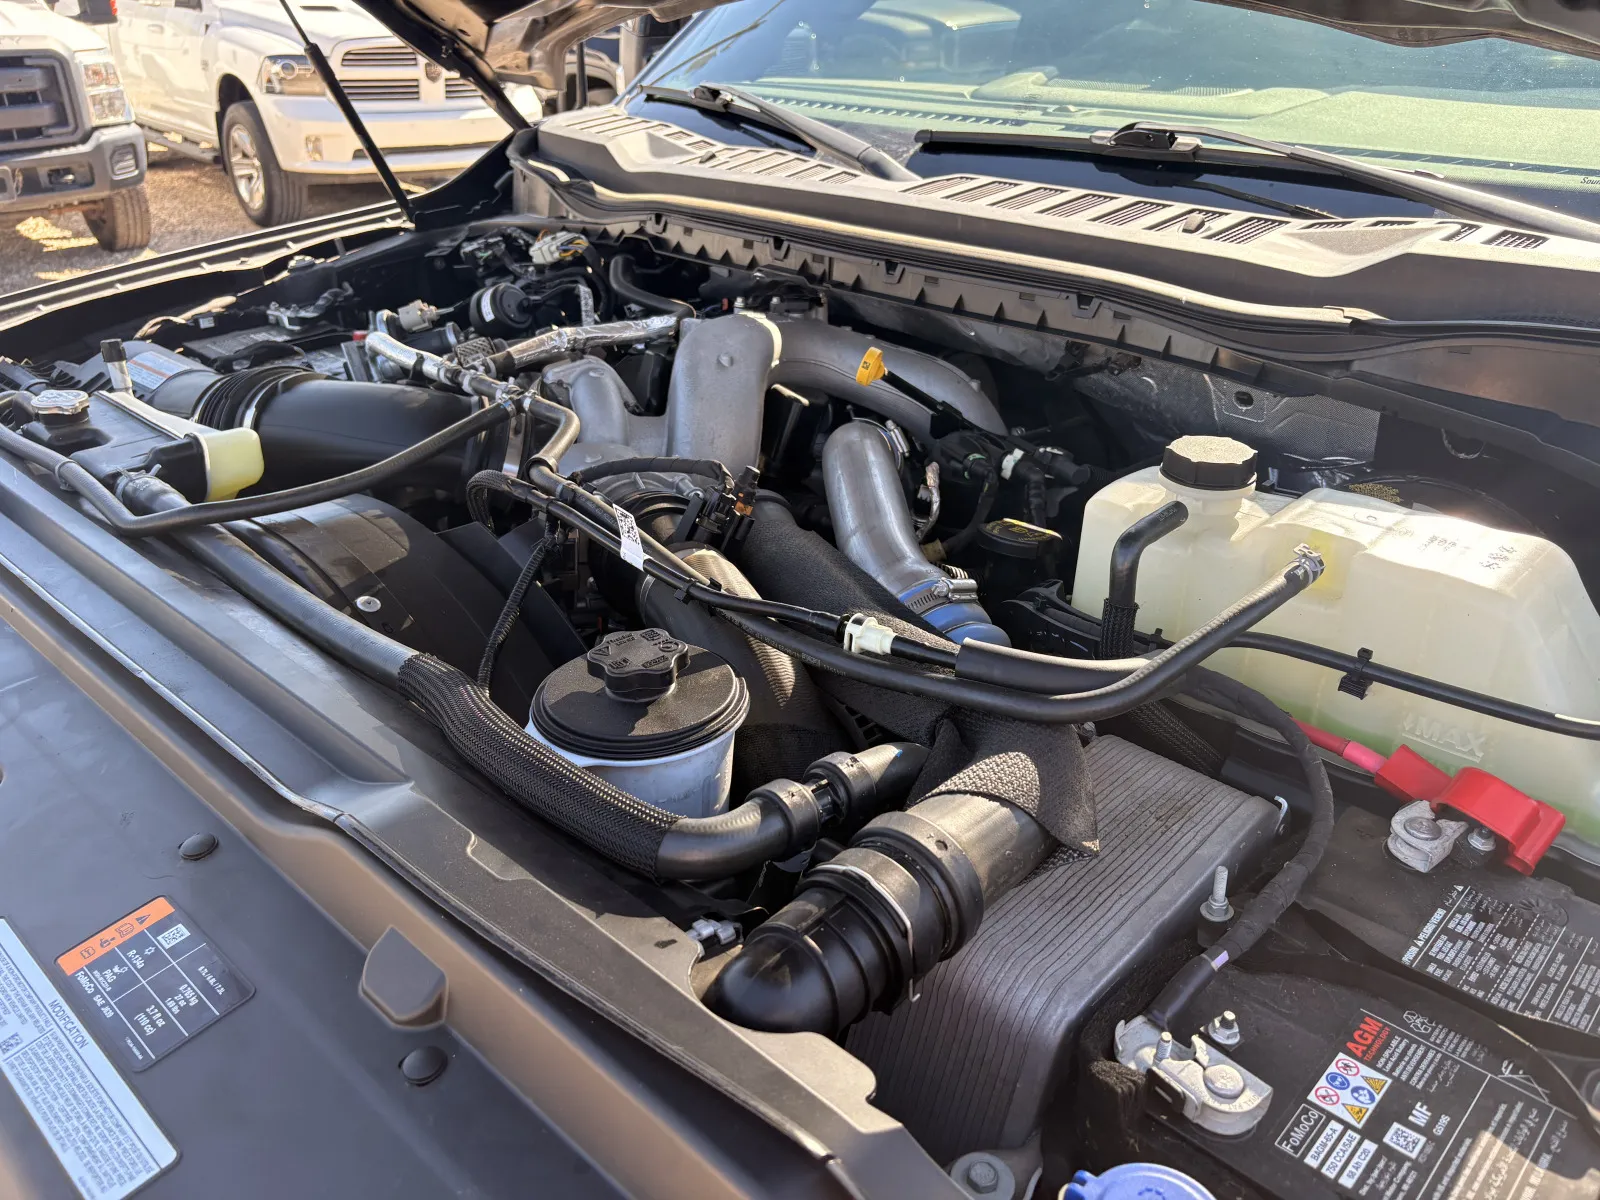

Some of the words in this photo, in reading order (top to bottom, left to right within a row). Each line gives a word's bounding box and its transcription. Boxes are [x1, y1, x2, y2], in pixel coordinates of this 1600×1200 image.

[1414, 716, 1486, 758] MAX
[101, 967, 117, 983] PAG
[126, 948, 145, 969] R-134a
[74, 969, 96, 994] FoMoCo
[92, 993, 105, 1006] SAE
[100, 1003, 115, 1018] J639
[144, 1003, 158, 1016] 3.7
[188, 995, 199, 1007] kg
[49, 999, 89, 1049] MODIFICATION
[132, 1011, 150, 1028] (110
[142, 1022, 157, 1036] cc)
[1345, 1015, 1382, 1057] AGM
[1364, 1026, 1391, 1061] TECHNOLOGY
[1375, 1034, 1402, 1069] NON-SPILLABLE
[1382, 1059, 1394, 1072] Lead
[1395, 1037, 1409, 1053] Battery
[1282, 1109, 1320, 1153] FoMoCo
[1408, 1101, 1432, 1128] MF
[1324, 1159, 1339, 1175] 750
[1332, 1132, 1357, 1163] CCA/SAE
[1351, 1158, 1363, 1172] Ah
[1357, 1146, 1371, 1161] C20
